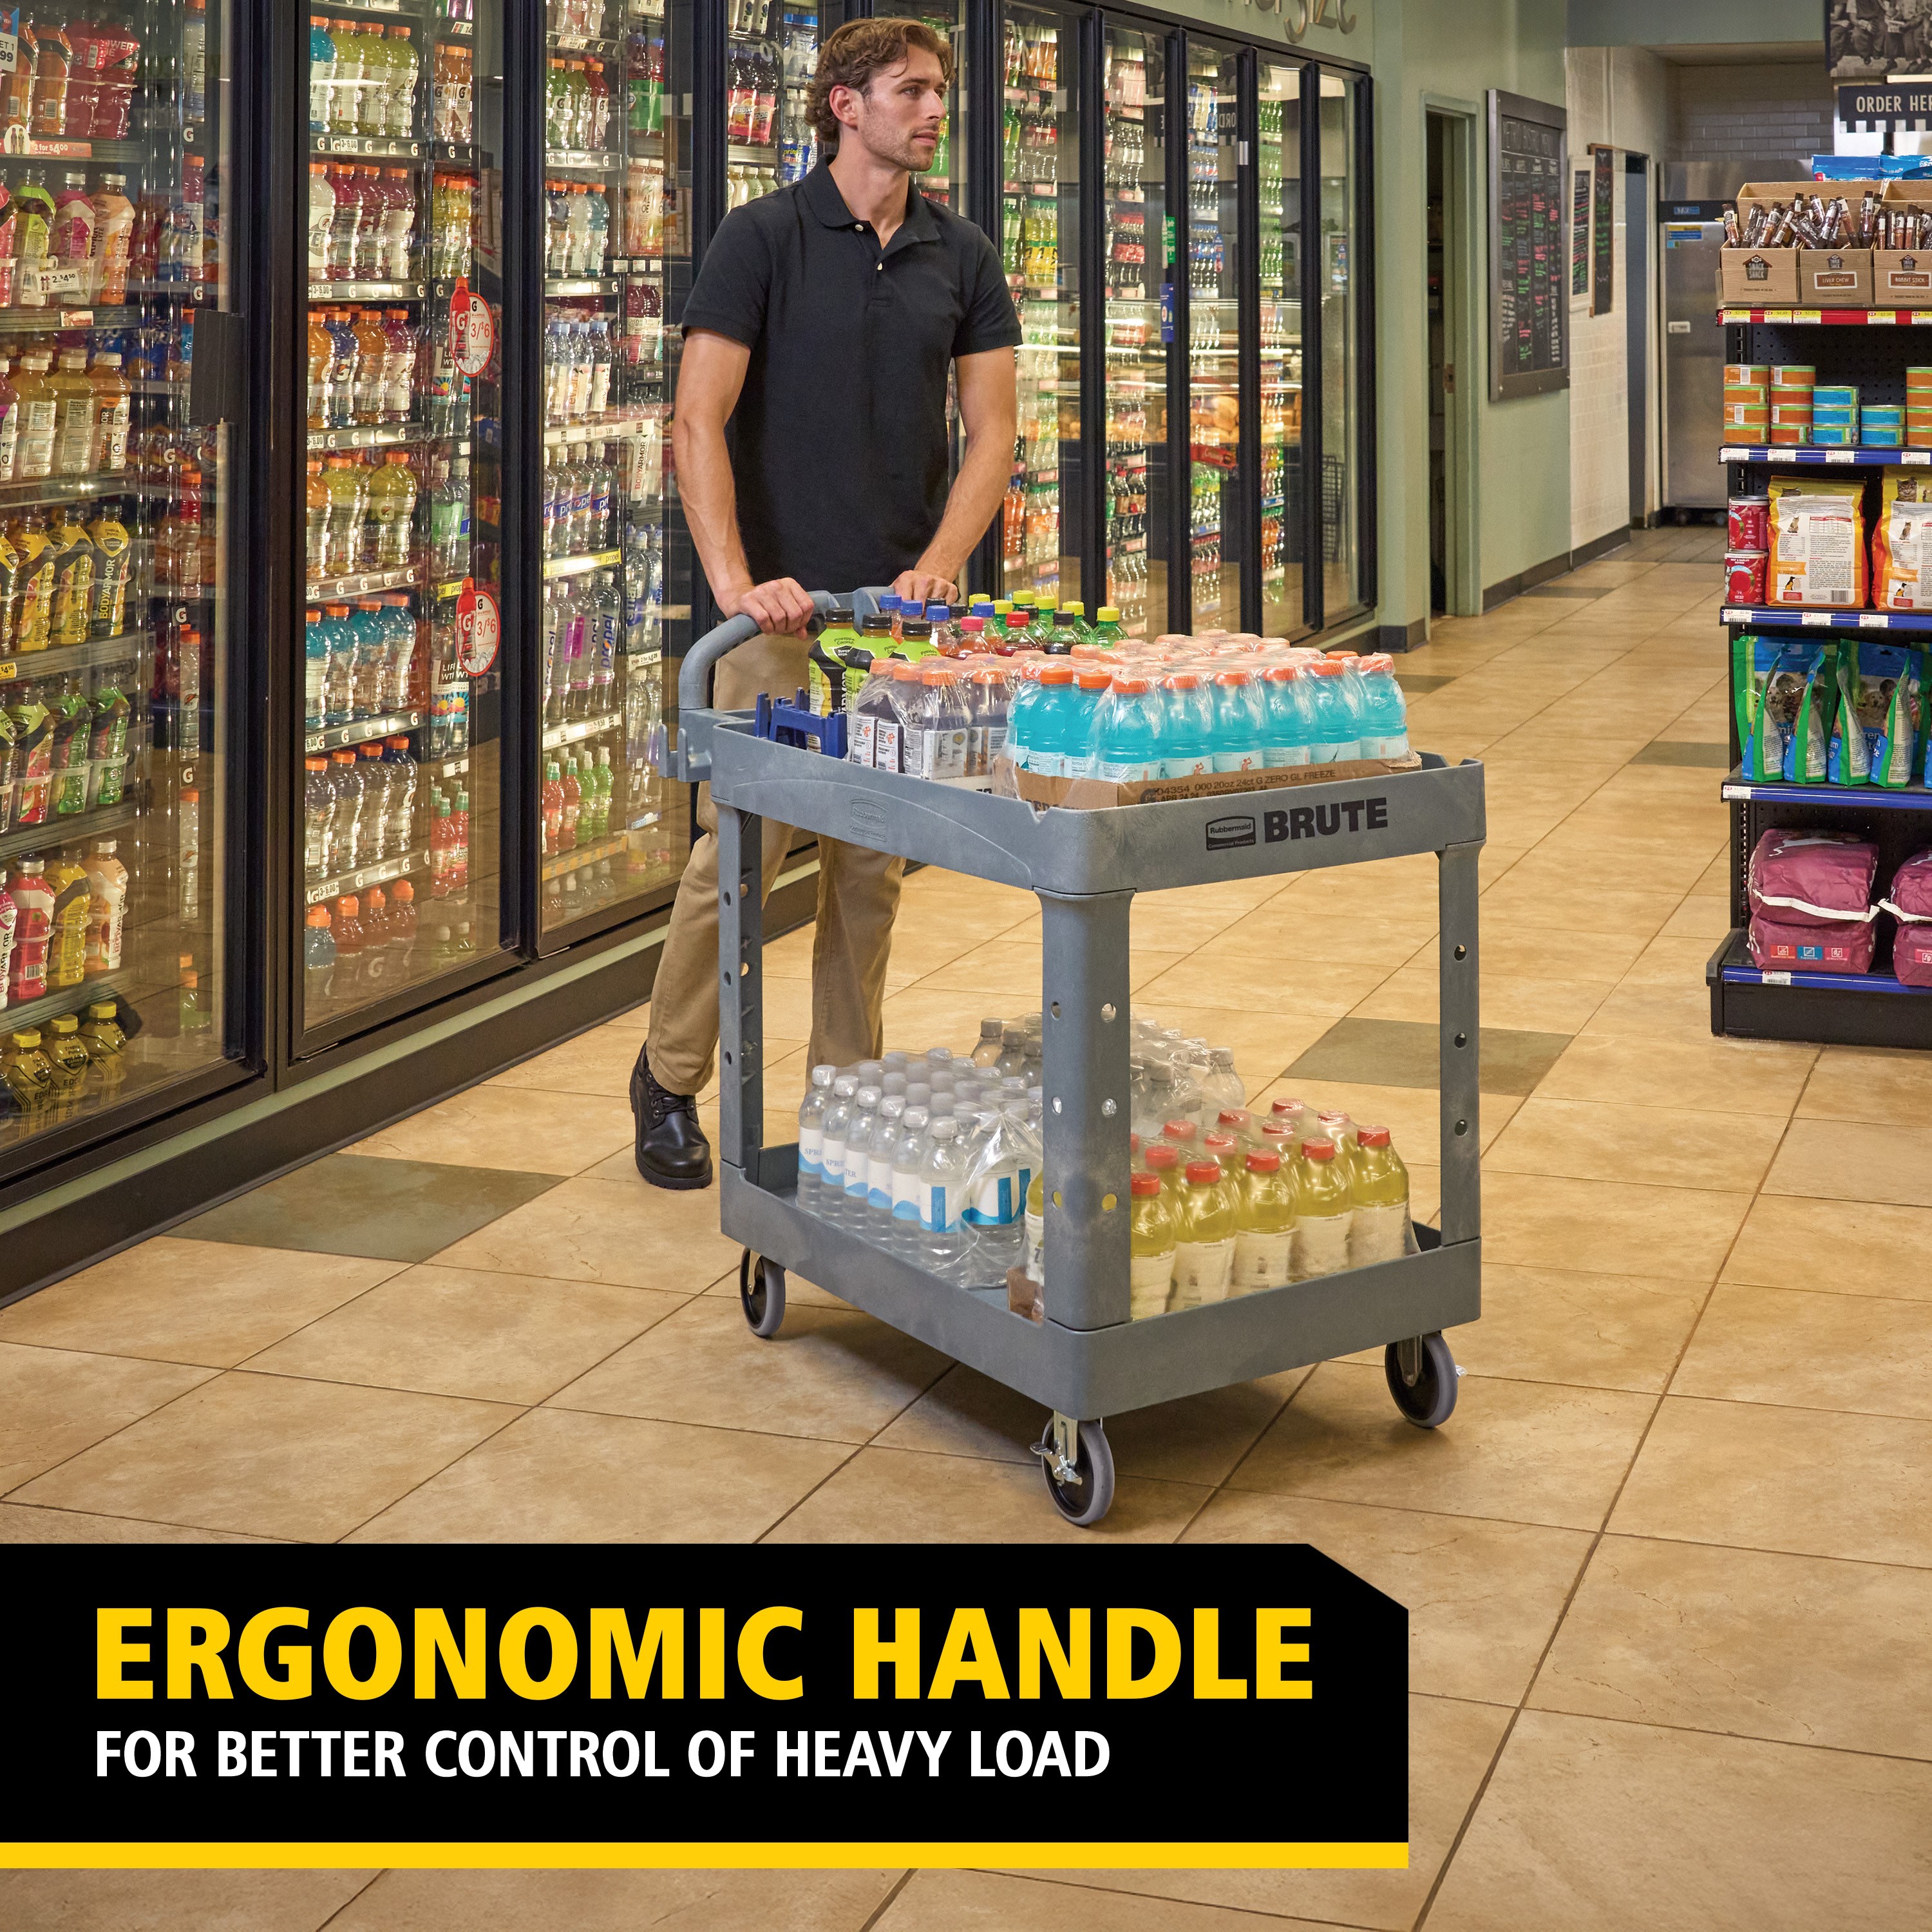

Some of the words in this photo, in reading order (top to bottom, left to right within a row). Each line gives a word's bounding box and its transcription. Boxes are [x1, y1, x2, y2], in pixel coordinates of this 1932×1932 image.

[1856, 96, 1902, 113] ORDER
[317, 137, 325, 150] G
[365, 140, 373, 153] G
[411, 143, 418, 156] G
[448, 146, 455, 158] G
[194, 286, 203, 301] G
[348, 285, 356, 298] G
[417, 285, 425, 298] G
[436, 284, 444, 297] G
[471, 301, 477, 312] G
[456, 313, 466, 330] G
[352, 432, 359, 445] G
[399, 428, 406, 440] G
[328, 435, 336, 448] G
[164, 448, 175, 463] G
[634, 441, 646, 489] BODYARMOR
[605, 552, 620, 565] propel
[406, 569, 414, 582] G
[99, 558, 116, 620] BODYARMOR
[336, 582, 344, 594] G
[360, 577, 368, 590] G
[478, 598, 483, 610] G
[176, 608, 187, 623] G
[462, 614, 471, 632] G
[601, 614, 615, 668] propel
[411, 712, 419, 725] G
[341, 730, 349, 743] G
[365, 724, 372, 737] G
[183, 767, 193, 783] G
[1195, 782, 1213, 791] 000
[1214, 780, 1235, 789] 20oz
[1236, 778, 1255, 786] 24ct
[1256, 776, 1264, 784] G
[1265, 774, 1289, 784] ZERO
[1290, 772, 1302, 781] GL
[1303, 770, 1336, 780] FREEZE
[1264, 797, 1388, 844] BRUTE
[1209, 823, 1251, 835] Rubbermaid
[1208, 841, 1235, 850] Commercial
[1235, 838, 1255, 846] Products
[402, 858, 410, 871] G
[356, 873, 363, 887] G
